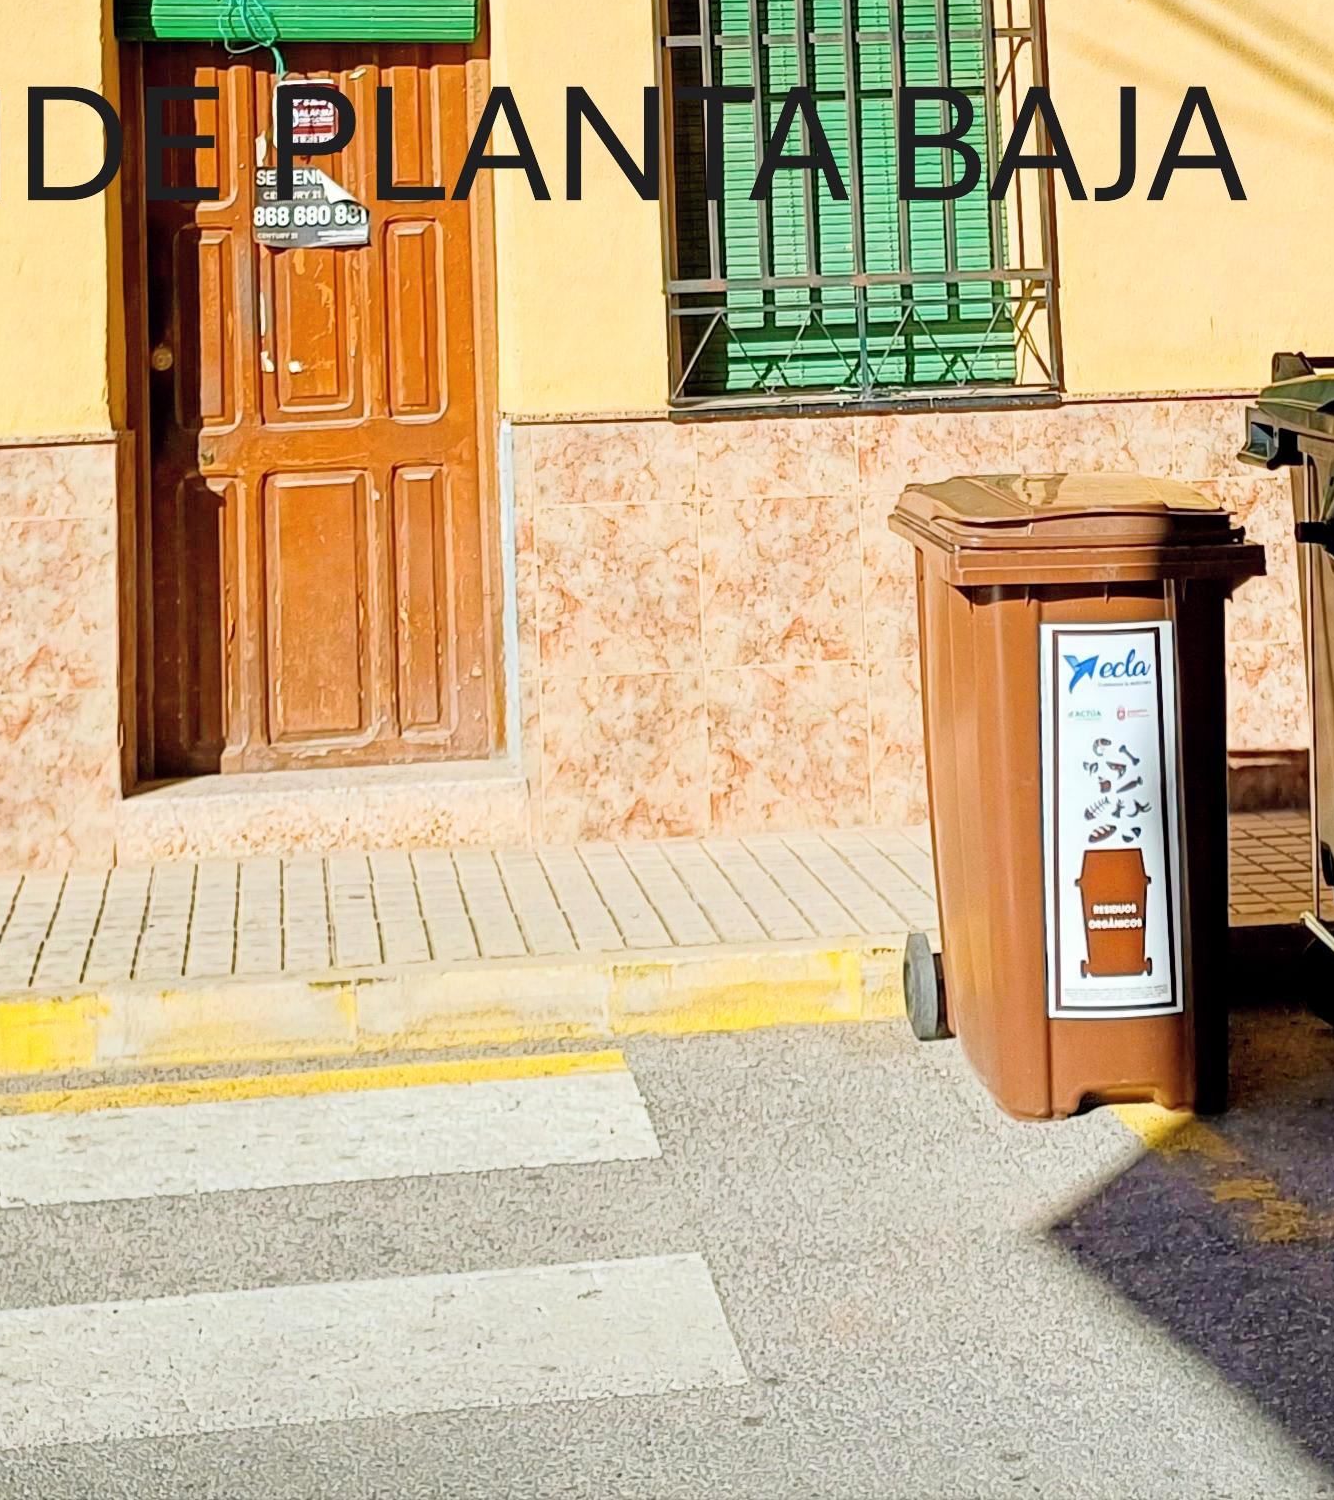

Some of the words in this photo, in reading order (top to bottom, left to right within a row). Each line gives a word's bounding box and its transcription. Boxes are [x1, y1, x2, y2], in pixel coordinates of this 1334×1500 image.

[256, 169, 277, 186] SE
[254, 206, 290, 227] 868
[293, 205, 331, 226] 680
[257, 232, 289, 240] CENTURY
[1093, 903, 1137, 914] RESIDUOS
